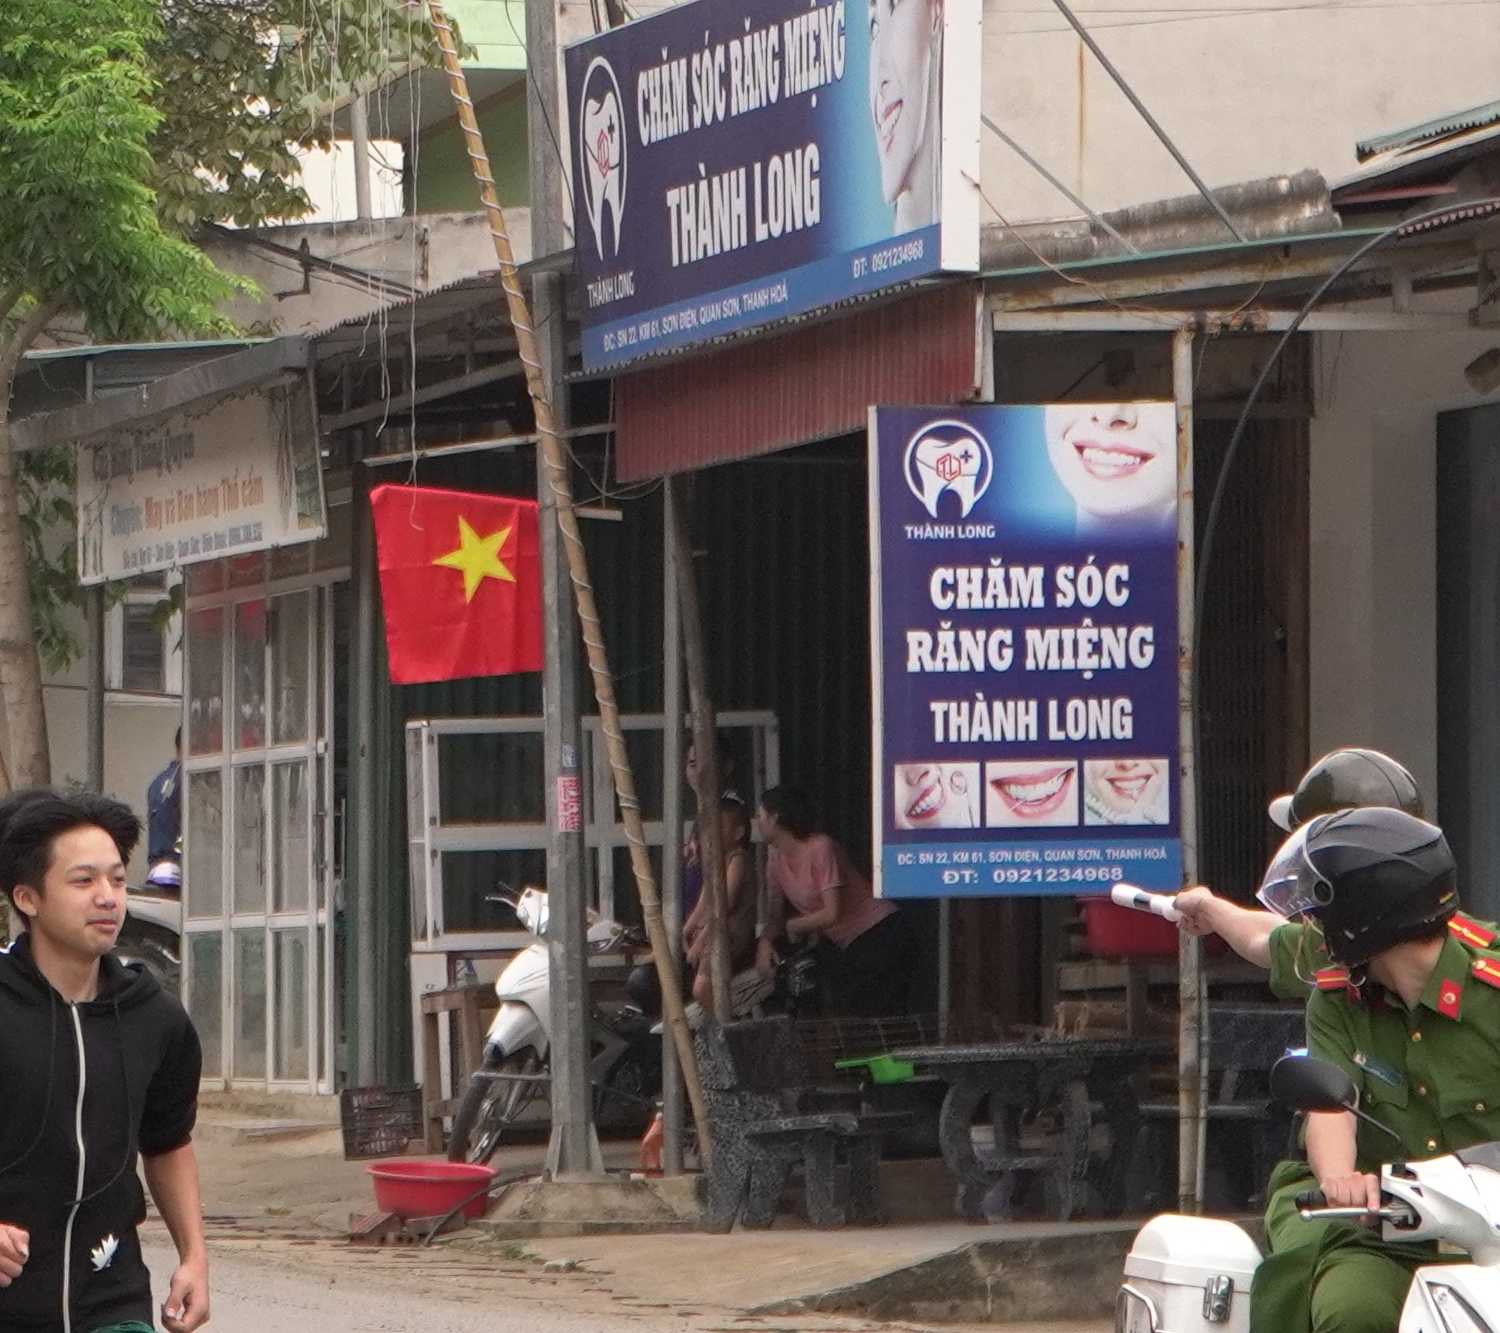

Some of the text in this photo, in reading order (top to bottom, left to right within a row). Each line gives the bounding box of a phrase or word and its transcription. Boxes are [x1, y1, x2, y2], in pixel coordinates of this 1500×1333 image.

[637, 46, 688, 146] CHĂM
[692, 32, 726, 130] SÓC
[730, 17, 780, 116] RĂNG
[667, 143, 820, 267] THÀNH LONG
[872, 239, 924, 273] 0921234968
[587, 271, 634, 308] THÀNH LONG
[638, 324, 650, 341] KM
[699, 302, 720, 325] QUAN
[742, 287, 769, 313] THANH
[904, 520, 995, 539] THÀNH LONG
[930, 554, 1130, 610] CHĂM SÓC
[907, 617, 1155, 681] RĂNG MIỆNG
[930, 691, 1134, 742] THÀNH LONG
[919, 853, 933, 864] SN
[953, 852, 968, 863] KM
[989, 850, 1012, 863] SƠN
[1044, 849, 1074, 862] QUAN
[1105, 848, 1141, 861] THANH
[1143, 846, 1167, 860] HOÁ
[942, 867, 1123, 884] ĐT: 0921234968
